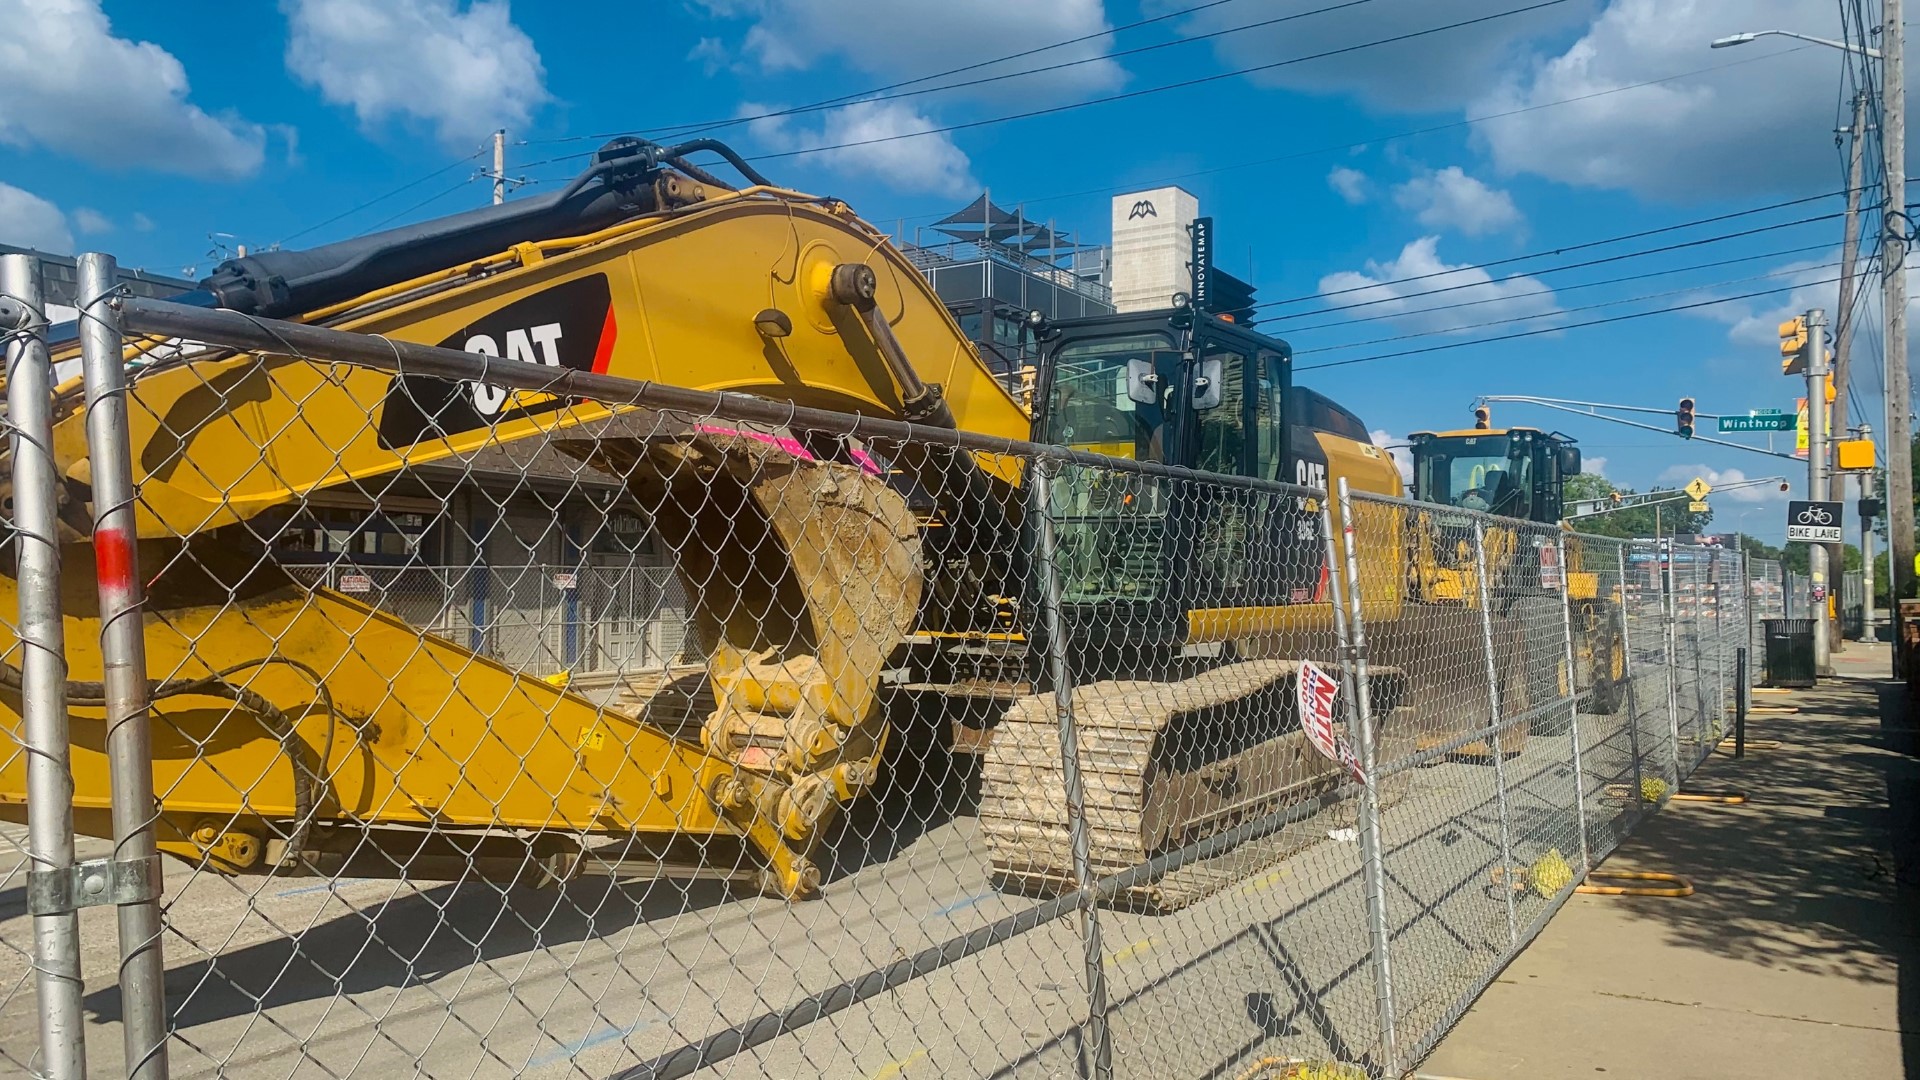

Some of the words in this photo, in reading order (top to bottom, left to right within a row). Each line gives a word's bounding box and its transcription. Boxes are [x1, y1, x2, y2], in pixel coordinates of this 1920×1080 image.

[464, 322, 563, 415] CAT
[1723, 419, 1788, 429] Winthrop
[1296, 459, 1325, 511] CAT
[1789, 527, 1810, 537] BIKE
[1814, 528, 1840, 539] LANE
